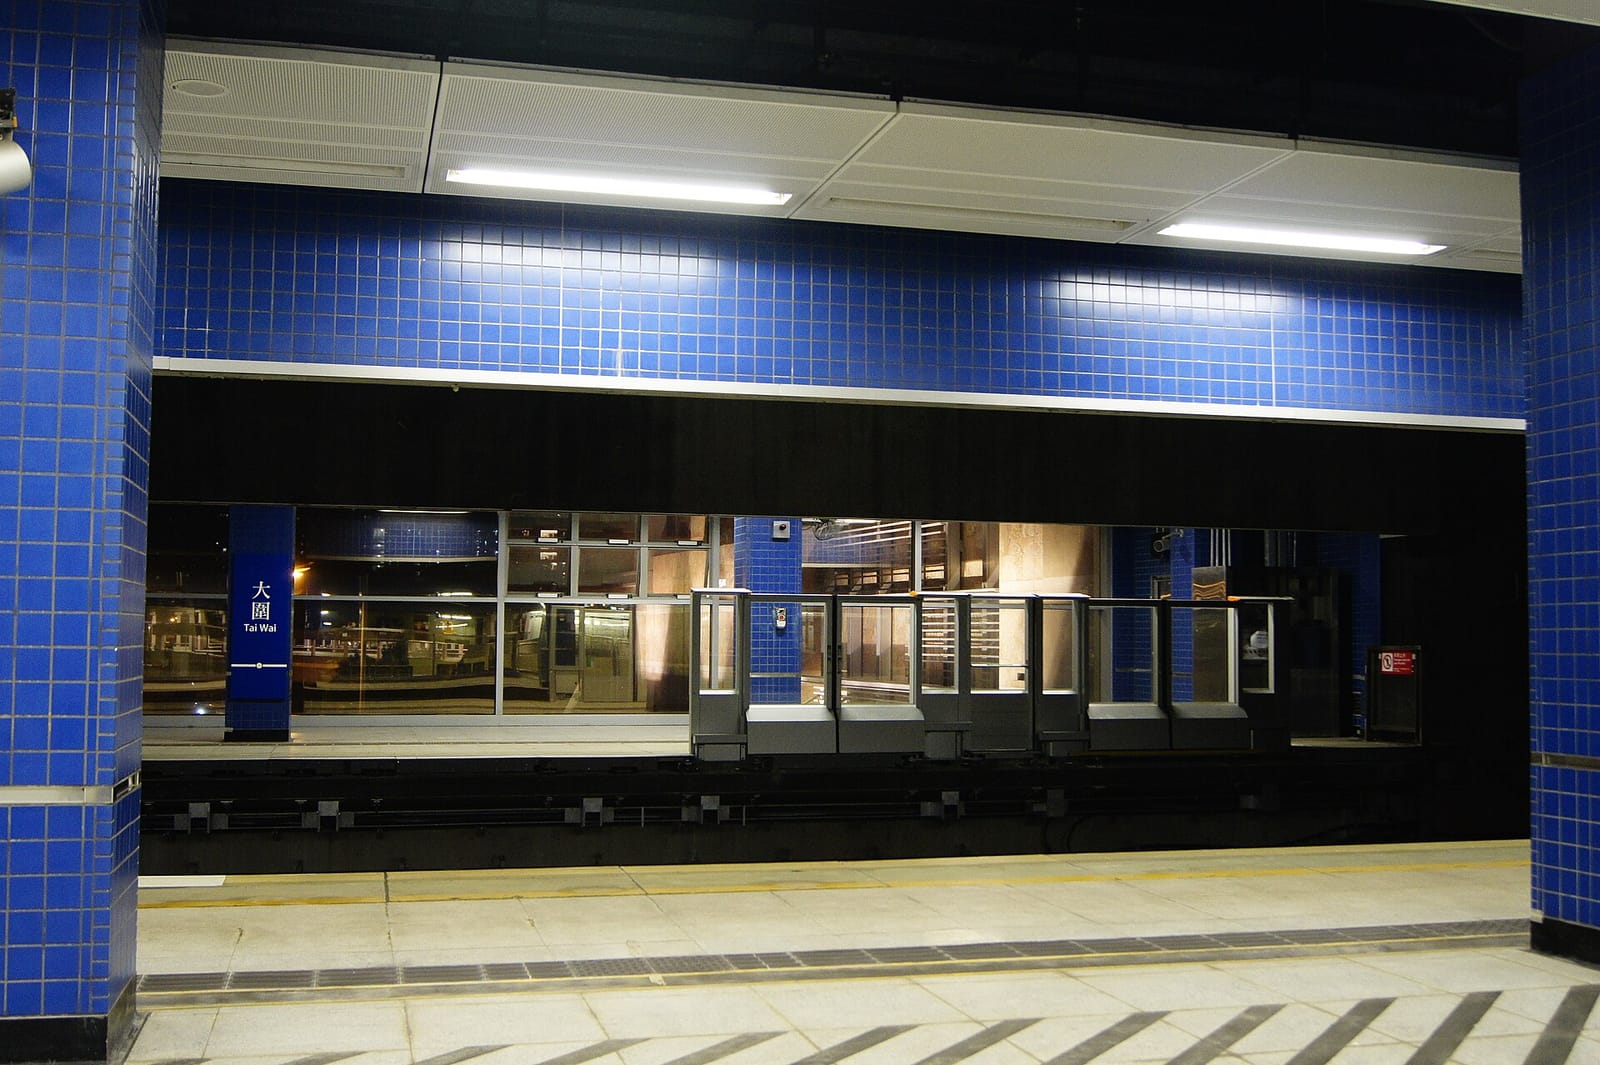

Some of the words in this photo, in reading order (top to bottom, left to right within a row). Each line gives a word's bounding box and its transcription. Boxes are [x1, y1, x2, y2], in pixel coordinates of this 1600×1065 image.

[251, 580, 271, 621] 大圍
[243, 623, 258, 633] Tai
[259, 623, 277, 633] Wai
